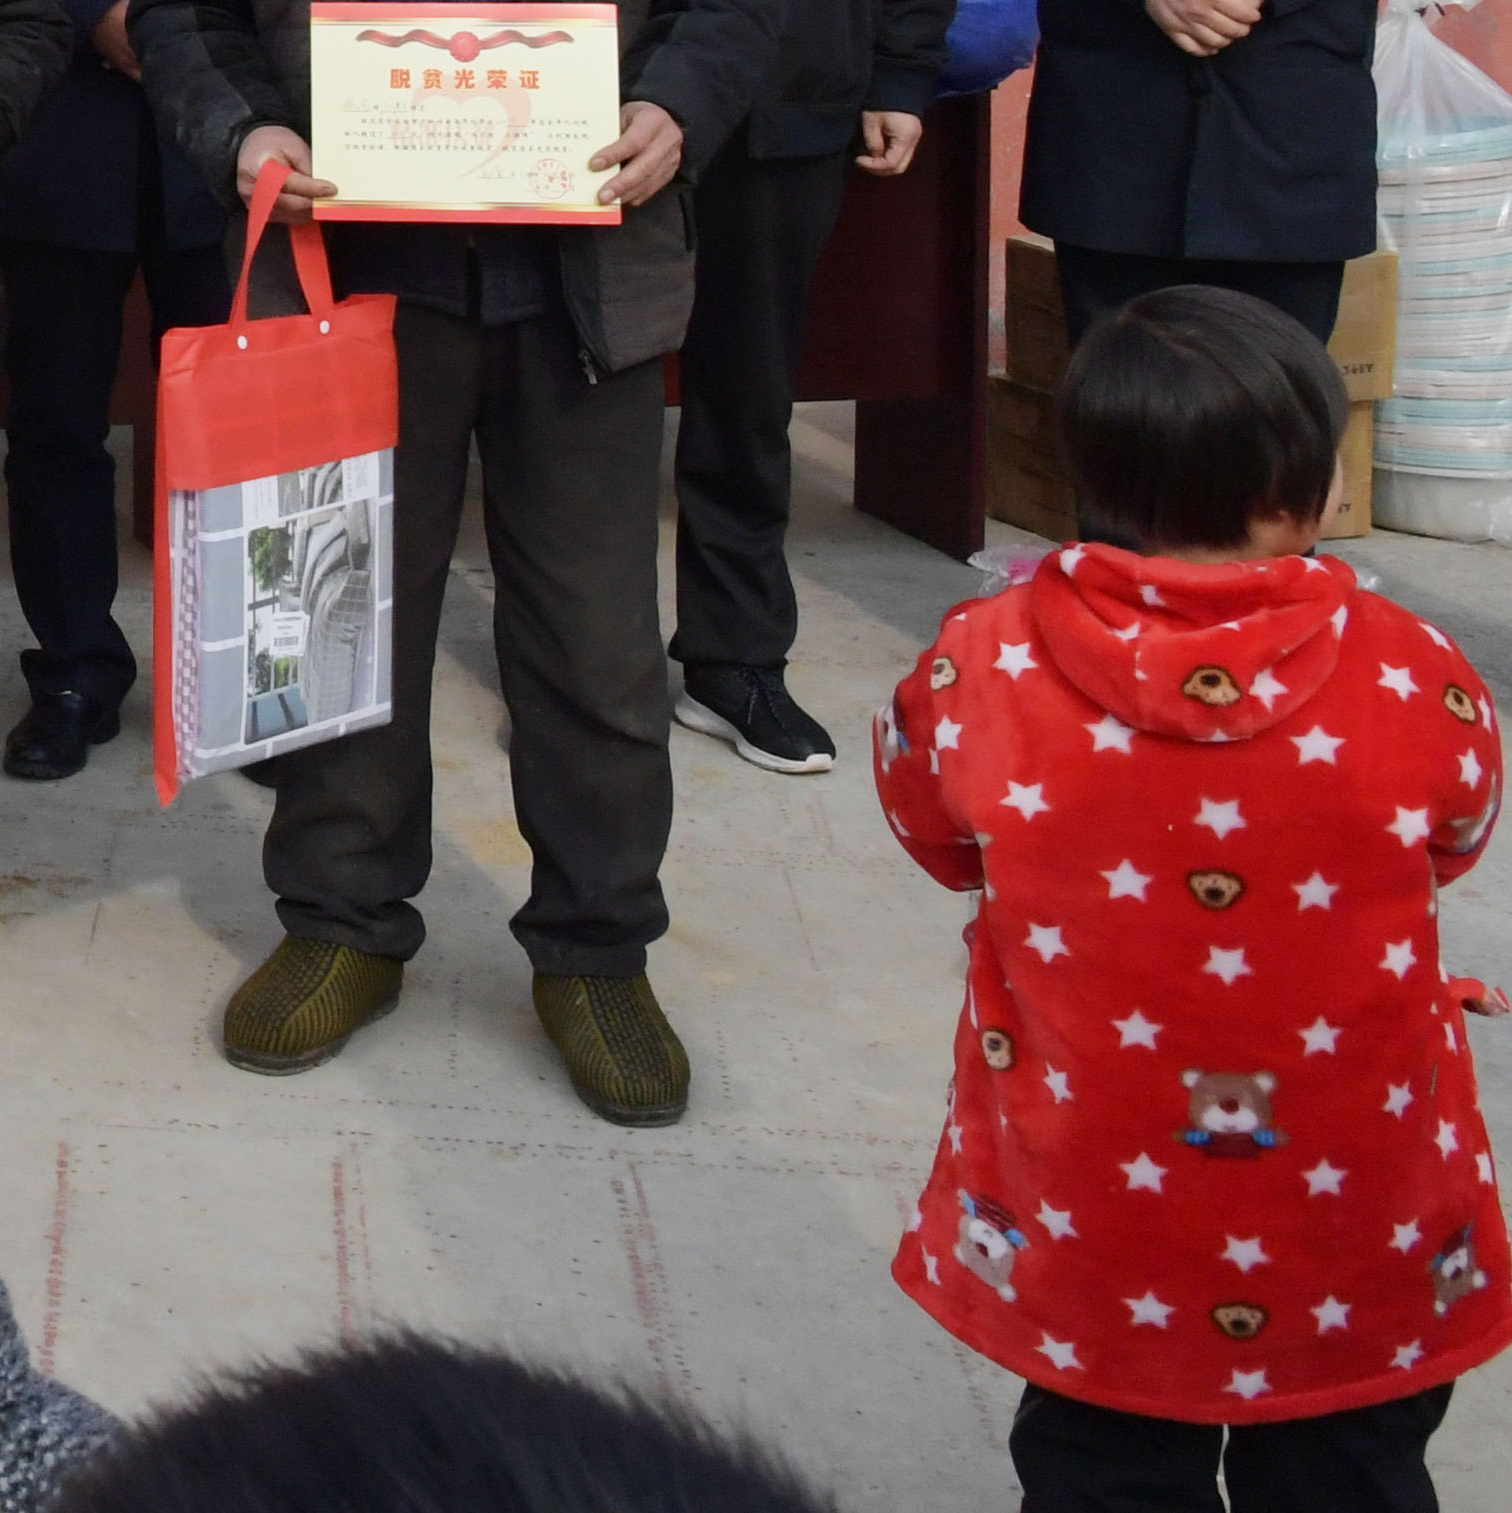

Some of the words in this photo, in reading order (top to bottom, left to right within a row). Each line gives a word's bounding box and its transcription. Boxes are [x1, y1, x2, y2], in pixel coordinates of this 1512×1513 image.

[389, 68, 541, 90] 脱贫光荣证
